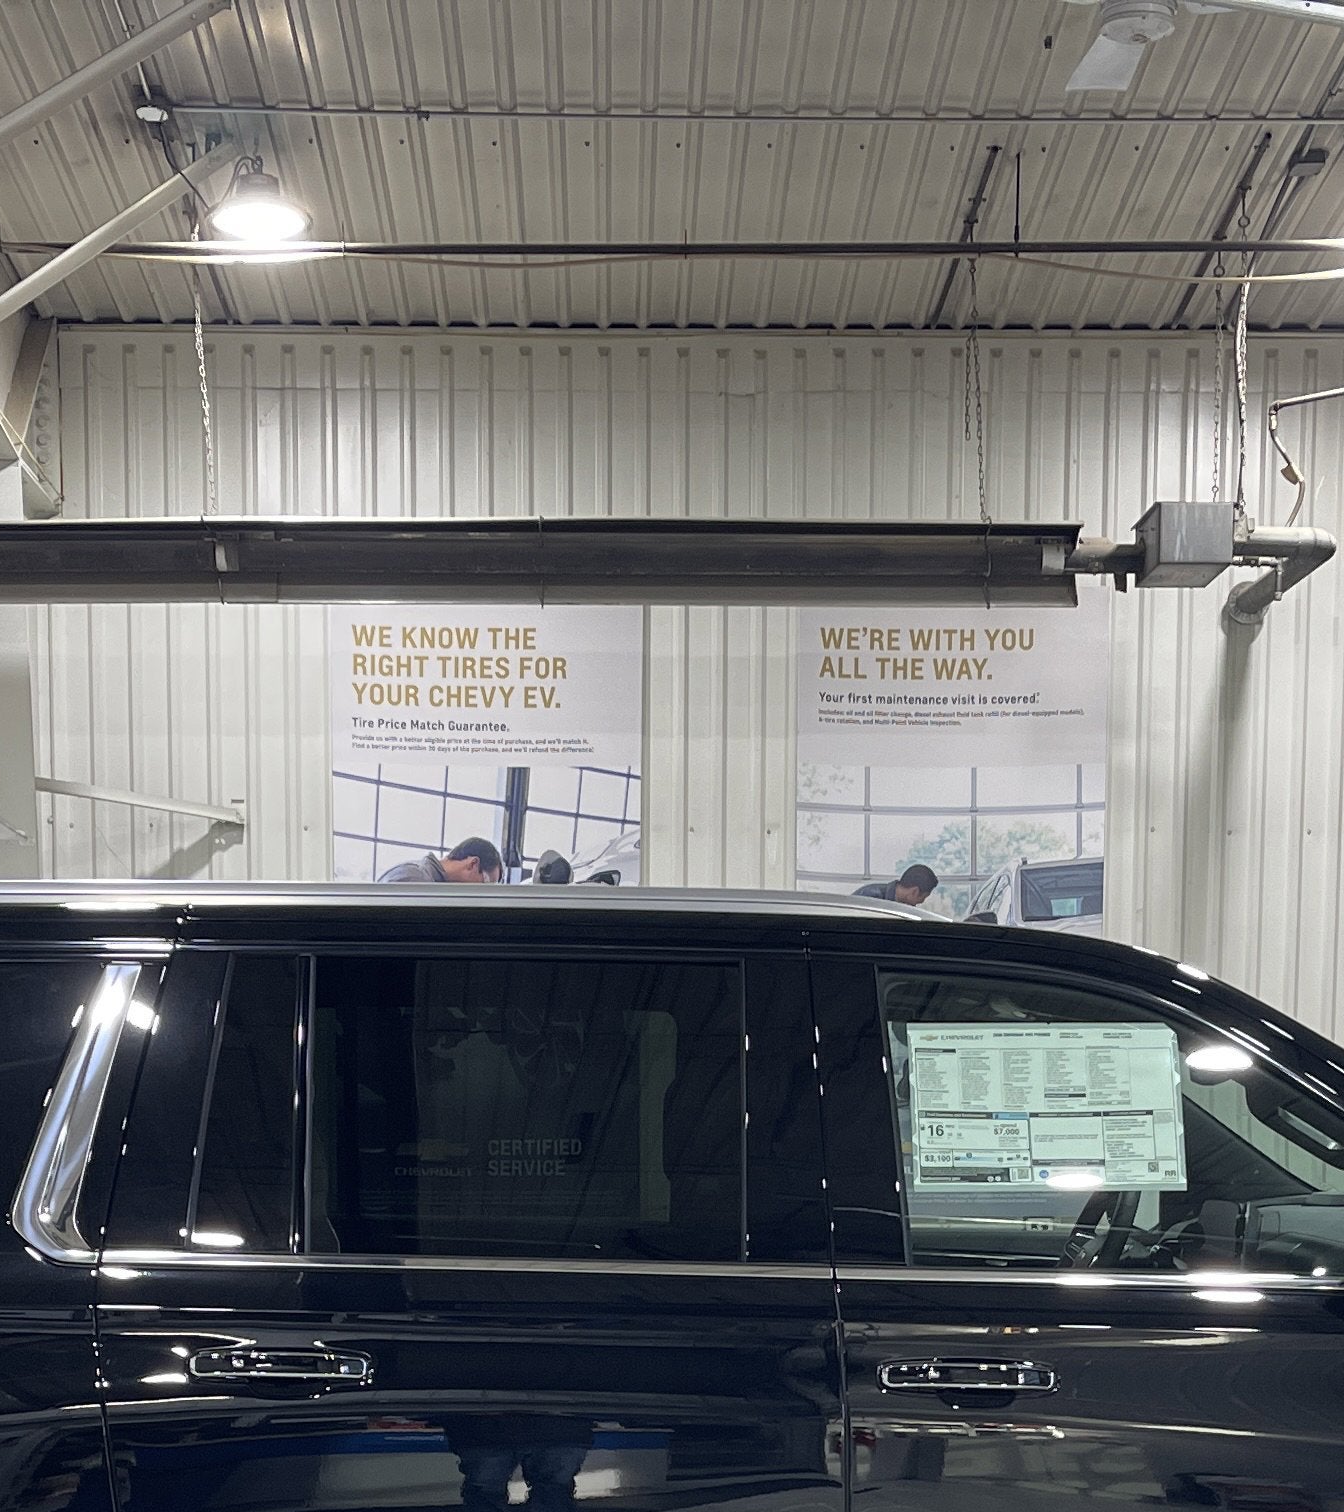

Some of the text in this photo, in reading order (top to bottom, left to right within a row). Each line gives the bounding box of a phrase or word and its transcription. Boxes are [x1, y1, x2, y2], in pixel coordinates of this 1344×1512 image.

[351, 624, 537, 650] WE KNOW THE
[820, 627, 1034, 651] WE'RE WITH YOU
[352, 653, 567, 679] RIGHT TIRES FOR
[819, 656, 993, 680] ALL THE WAY.
[351, 682, 561, 708] YOUR CHEVY EV.
[818, 692, 844, 703] Your
[848, 692, 872, 704] first
[876, 694, 949, 705] maintenance
[952, 694, 975, 705] visit
[978, 694, 988, 705] is
[351, 717, 374, 729] Tire
[378, 718, 407, 730] Price
[410, 719, 445, 731] Match
[928, 1124, 944, 1137] 16
[488, 1139, 582, 1156] CERTIFIED
[487, 1159, 566, 1176] SERVICE
